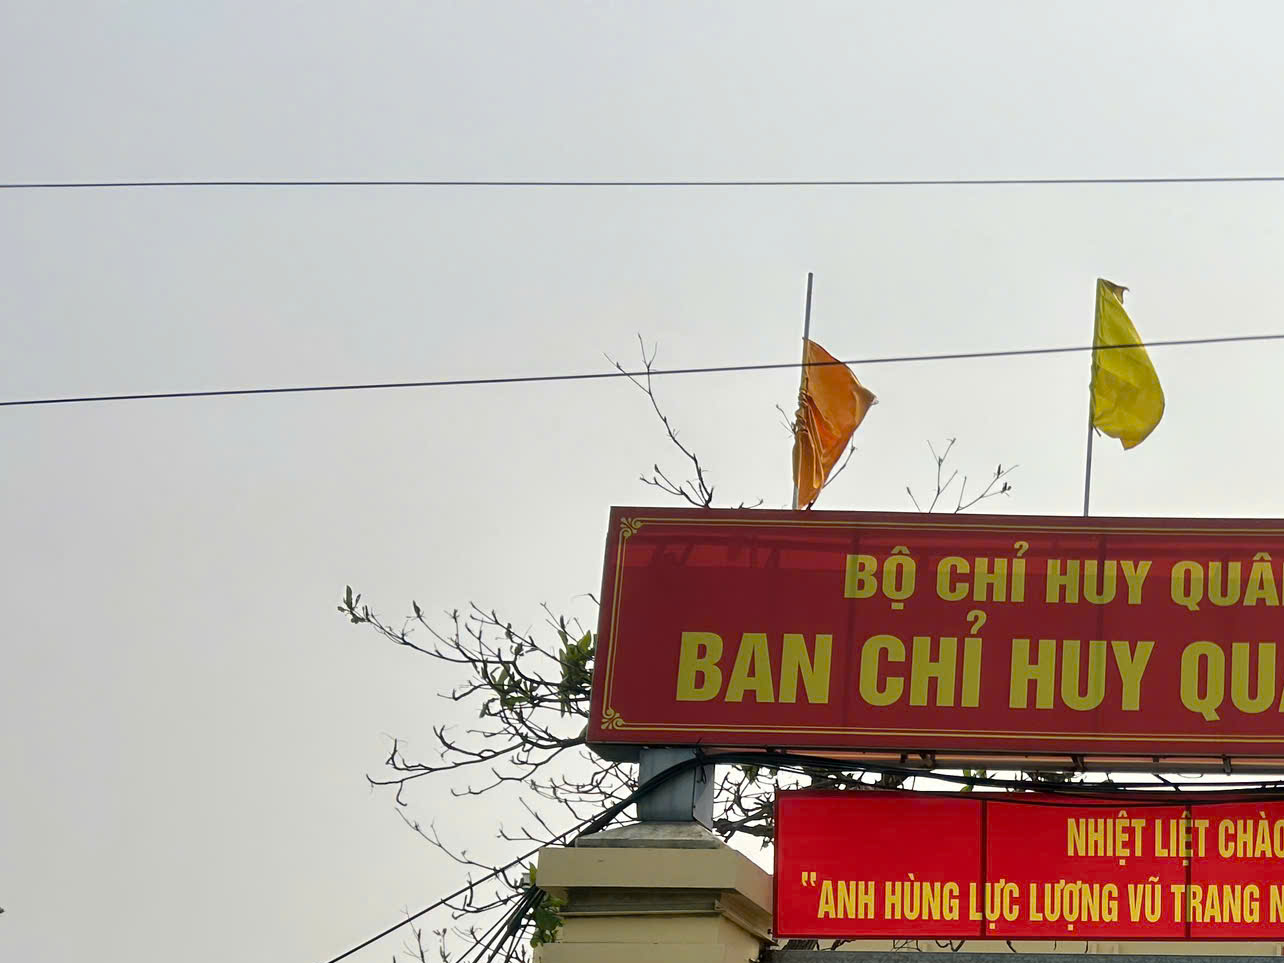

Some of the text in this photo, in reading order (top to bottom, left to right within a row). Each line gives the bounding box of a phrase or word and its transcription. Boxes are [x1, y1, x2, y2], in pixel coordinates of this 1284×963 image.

[844, 546, 916, 610] BỘ
[936, 541, 1029, 604] CHỈ
[1046, 559, 1152, 605] HUY
[675, 631, 833, 704] BAN
[859, 610, 987, 709] CHỈ
[1008, 638, 1155, 711] HUY
[1067, 810, 1145, 866] NHIỆT
[1154, 811, 1209, 866] LIỆT
[801, 871, 876, 919] “ANH
[884, 873, 960, 921] HÙNG
[968, 879, 1020, 930] LỰC
[1029, 879, 1119, 931] LƯỢNG
[1127, 876, 1163, 922] VŨ
[1170, 884, 1263, 923] TRANG
